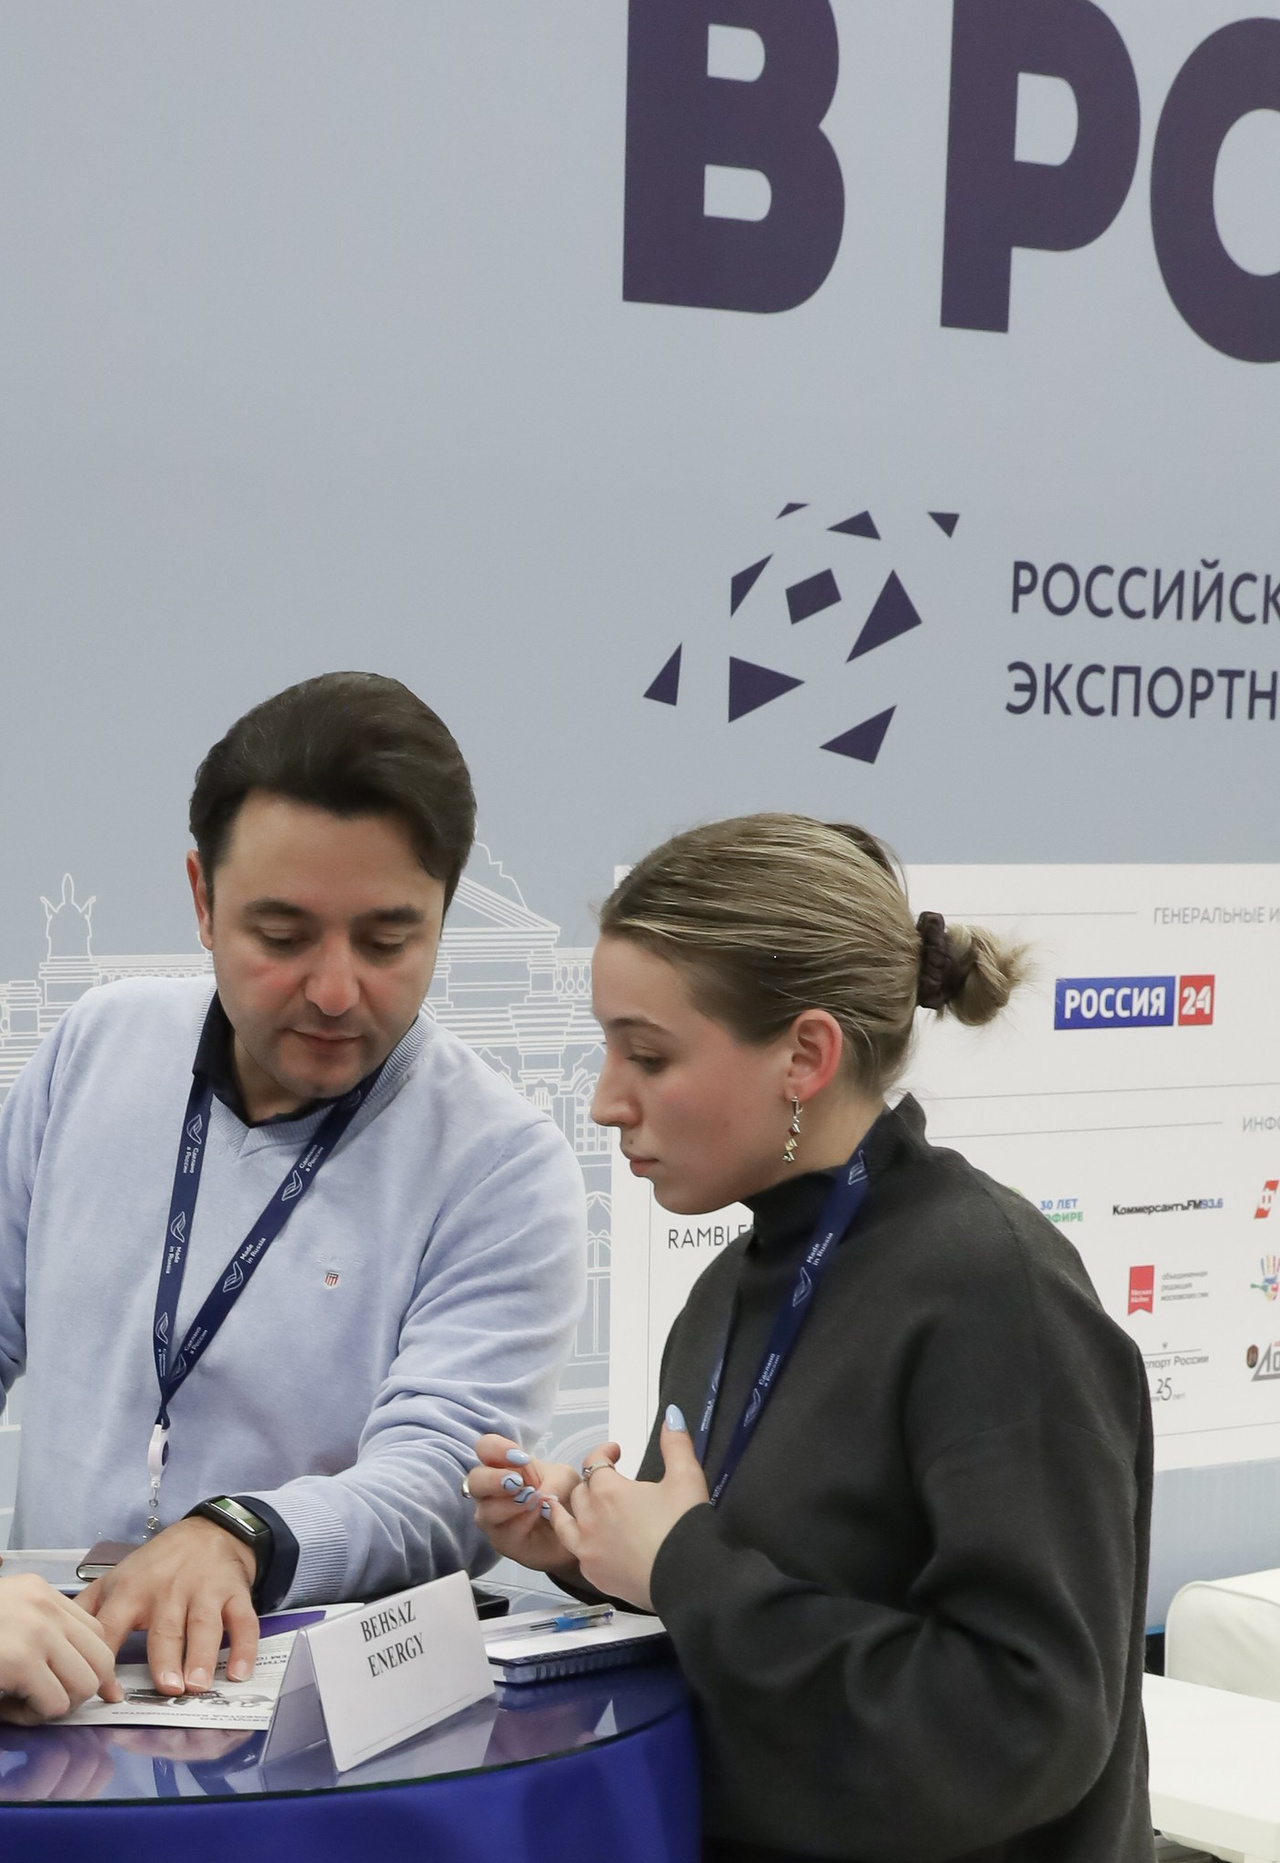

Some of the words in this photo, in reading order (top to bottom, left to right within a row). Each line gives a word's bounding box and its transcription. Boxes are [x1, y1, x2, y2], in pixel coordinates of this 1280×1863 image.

[622, 0, 846, 314] В
[1011, 558, 1280, 625] РОССИЙСК
[1005, 660, 1279, 721] ЭКСПОРТН
[1153, 906, 1266, 925] ГЕНЕРАЛЬНЫЕ
[1063, 986, 1167, 1019] РОССИЯ
[1181, 985, 1212, 1016] 24
[1242, 1115, 1280, 1132] ИНФ
[1040, 1200, 1054, 1211] 30
[1056, 1198, 1079, 1210] ЛЕТ
[251, 1237, 266, 1258] Russia
[668, 1224, 754, 1249] RAMBL
[240, 1243, 254, 1260] Made
[1173, 1355, 1209, 1366] России
[1157, 1377, 1172, 1401] 25
[360, 1600, 417, 1642] BEHSAZ
[366, 1631, 425, 1677] ENERGY
